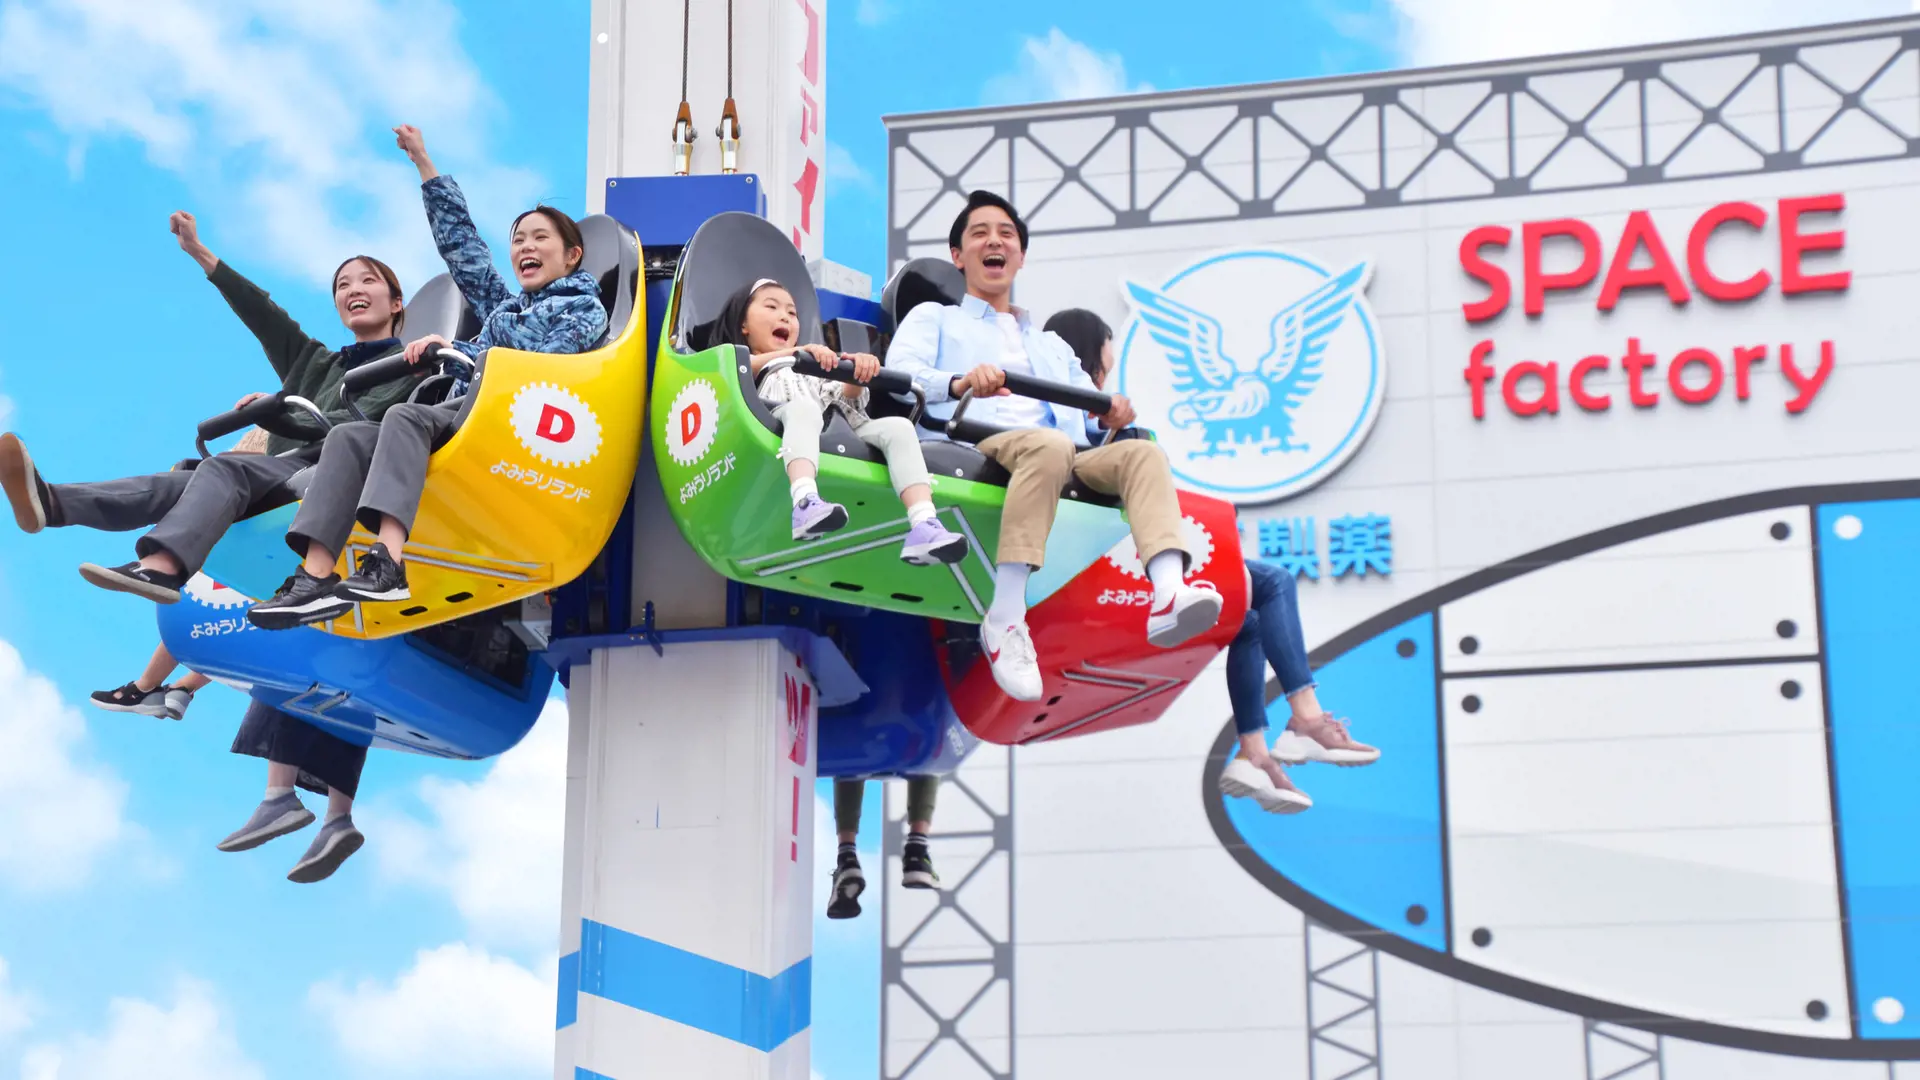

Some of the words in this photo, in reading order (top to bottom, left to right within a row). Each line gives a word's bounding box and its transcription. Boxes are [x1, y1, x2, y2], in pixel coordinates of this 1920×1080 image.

[1459, 193, 1853, 323] SPACE
[1464, 337, 1835, 420] factory
[535, 403, 576, 443] D
[681, 402, 702, 447] D
[1237, 511, 1392, 581] 製薬
[1096, 588, 1155, 607] よみう
